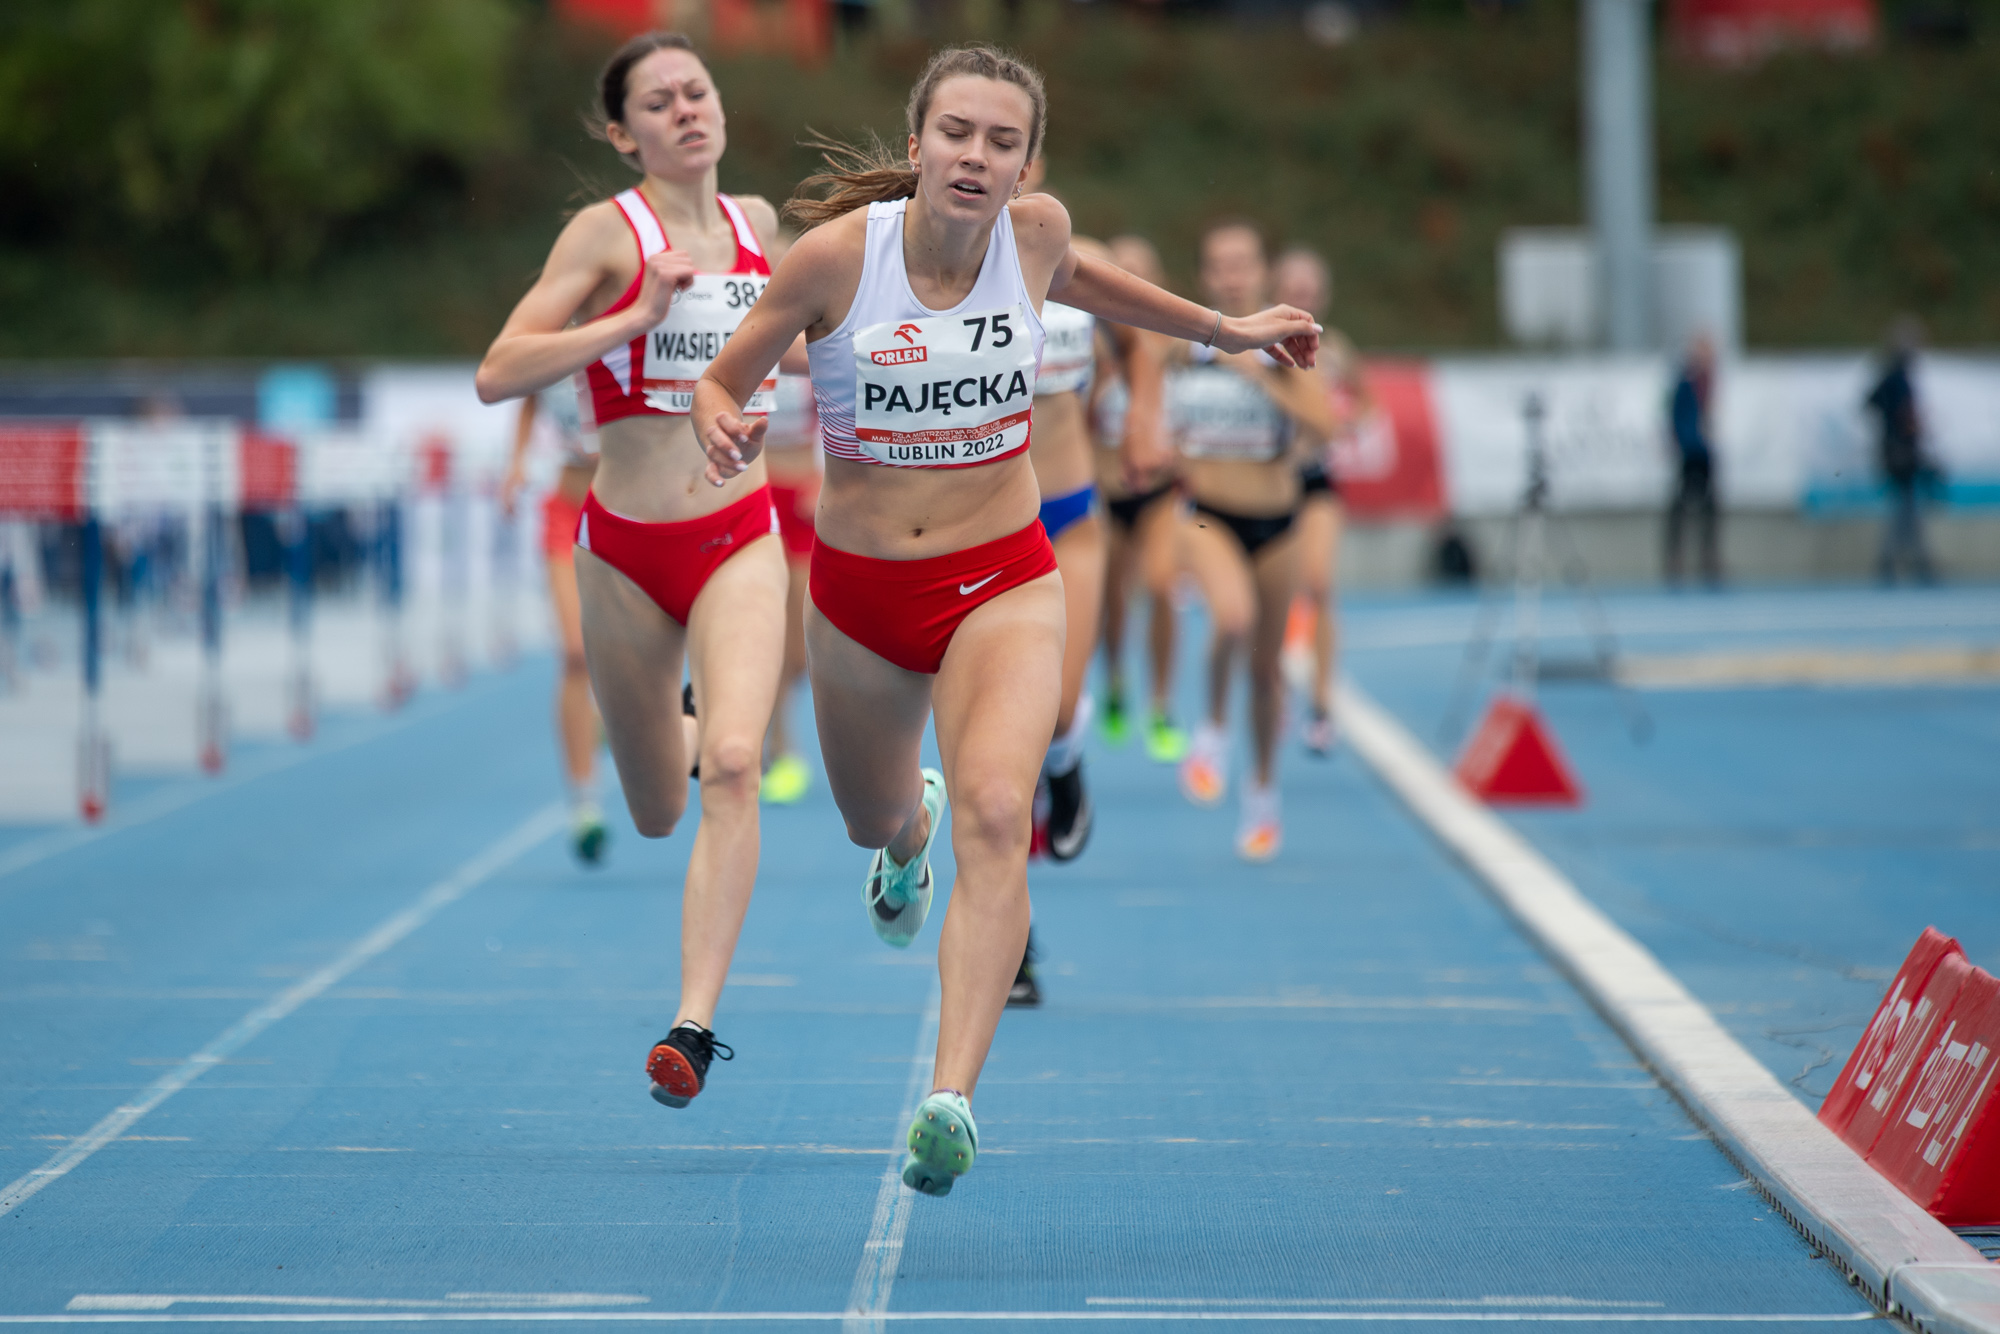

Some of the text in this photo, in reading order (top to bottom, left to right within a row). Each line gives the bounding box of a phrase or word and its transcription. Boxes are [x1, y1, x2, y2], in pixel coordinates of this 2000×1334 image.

[724, 281, 767, 309] 38
[963, 313, 1013, 352] 75
[873, 347, 925, 365] ORLEN
[864, 369, 1028, 416] PAJĘCKA
[889, 433, 1005, 460] LUBLIN 2022
